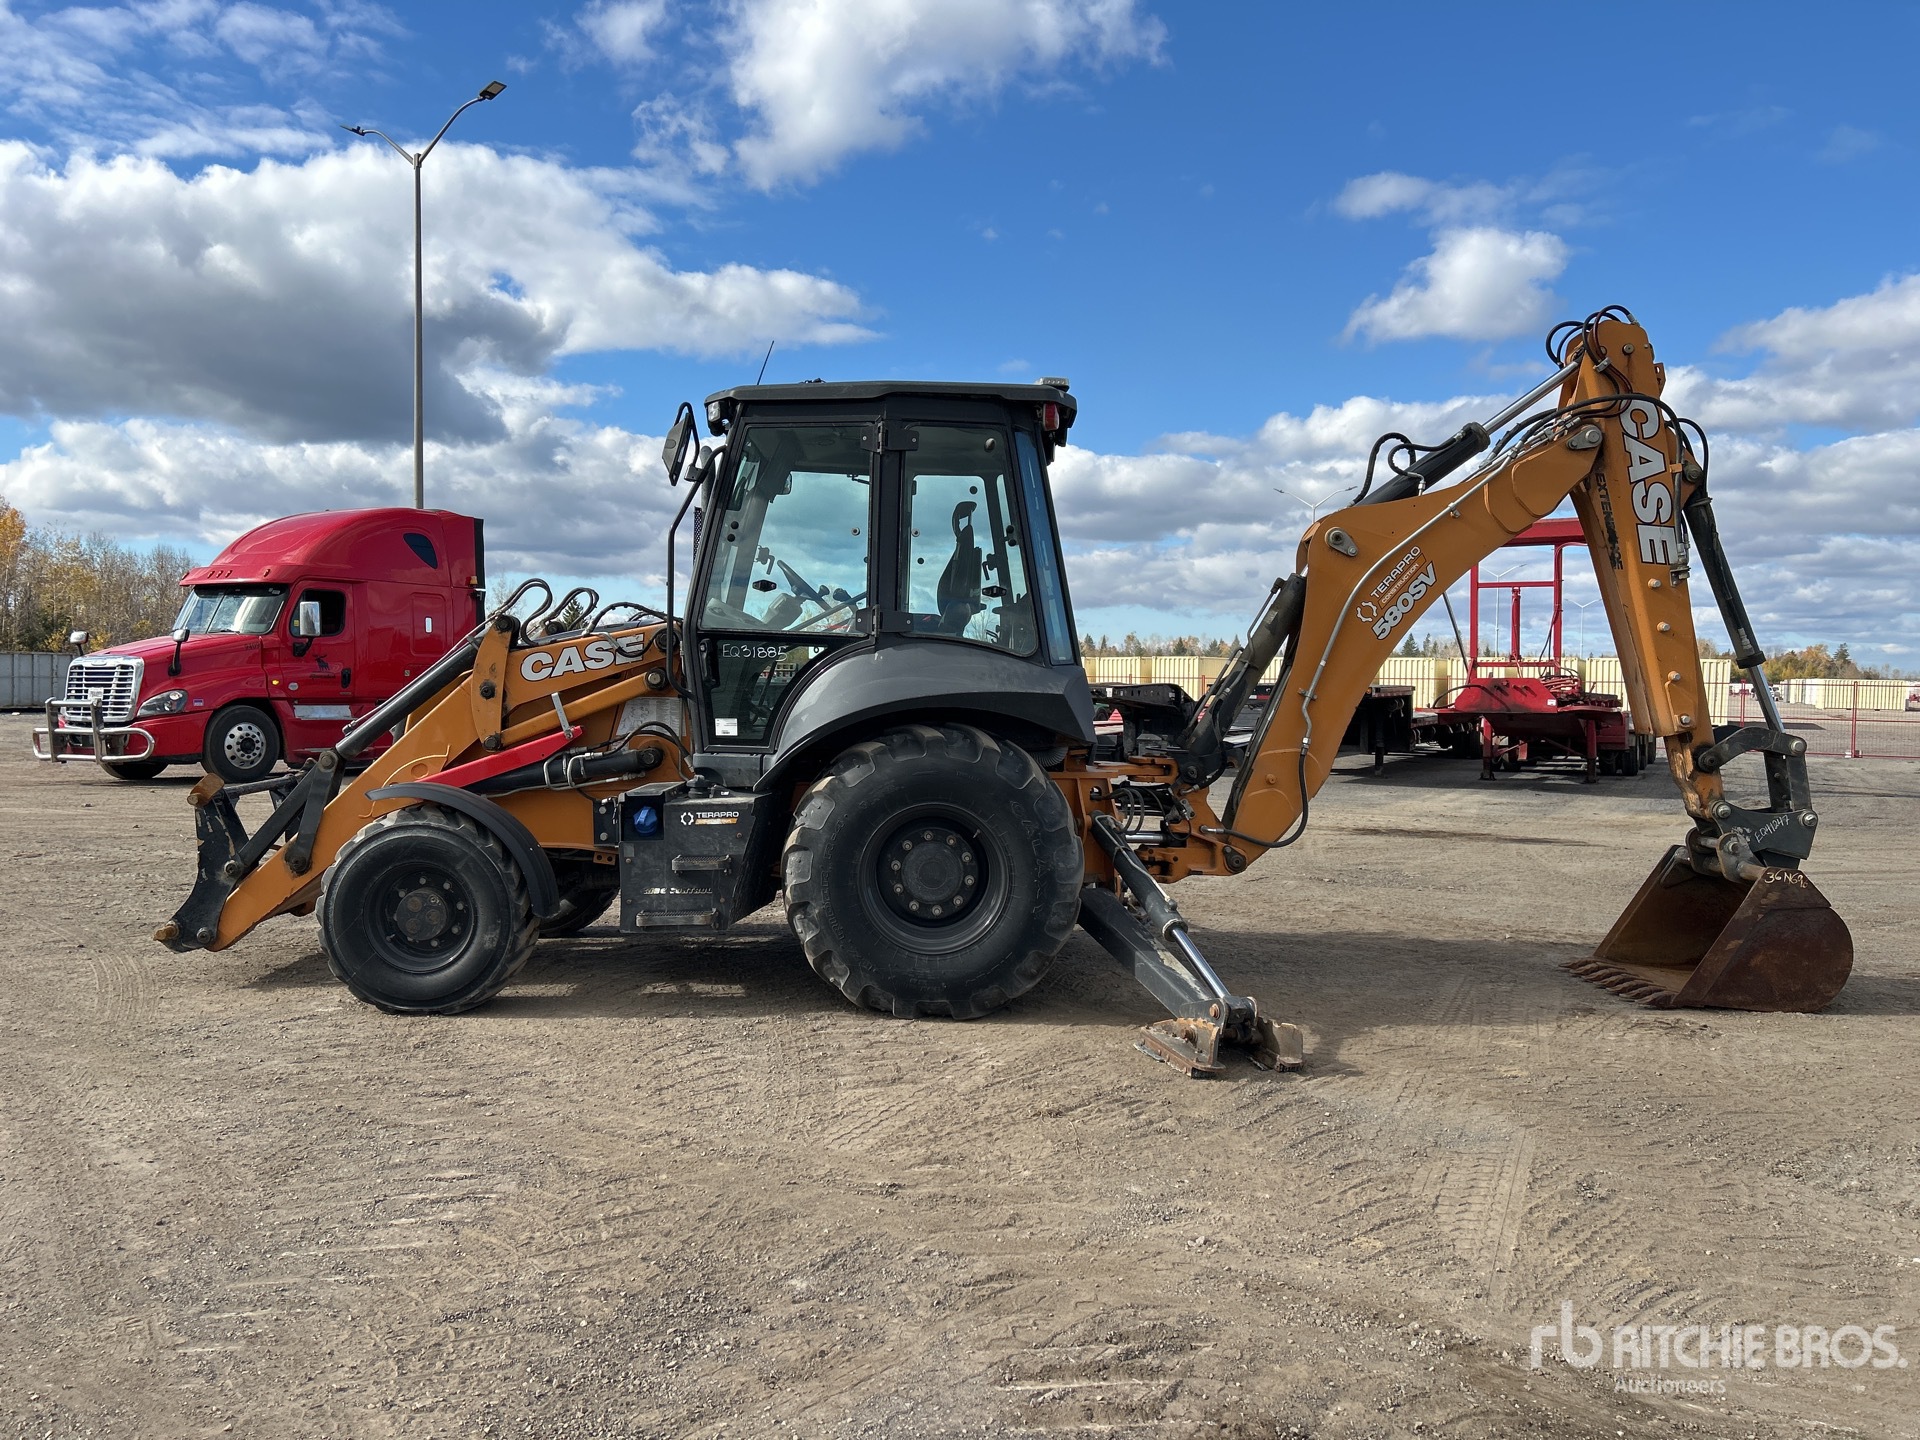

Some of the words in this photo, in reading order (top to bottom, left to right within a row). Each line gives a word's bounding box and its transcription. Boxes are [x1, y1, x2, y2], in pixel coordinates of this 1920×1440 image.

[1619, 394, 1679, 565] CASE
[1370, 546, 1421, 598] TERAPRO
[1381, 563, 1419, 604] CONSTRUCTION
[1371, 560, 1437, 640] 580SV
[520, 633, 645, 682] CASE
[722, 643, 788, 662] EQ31885
